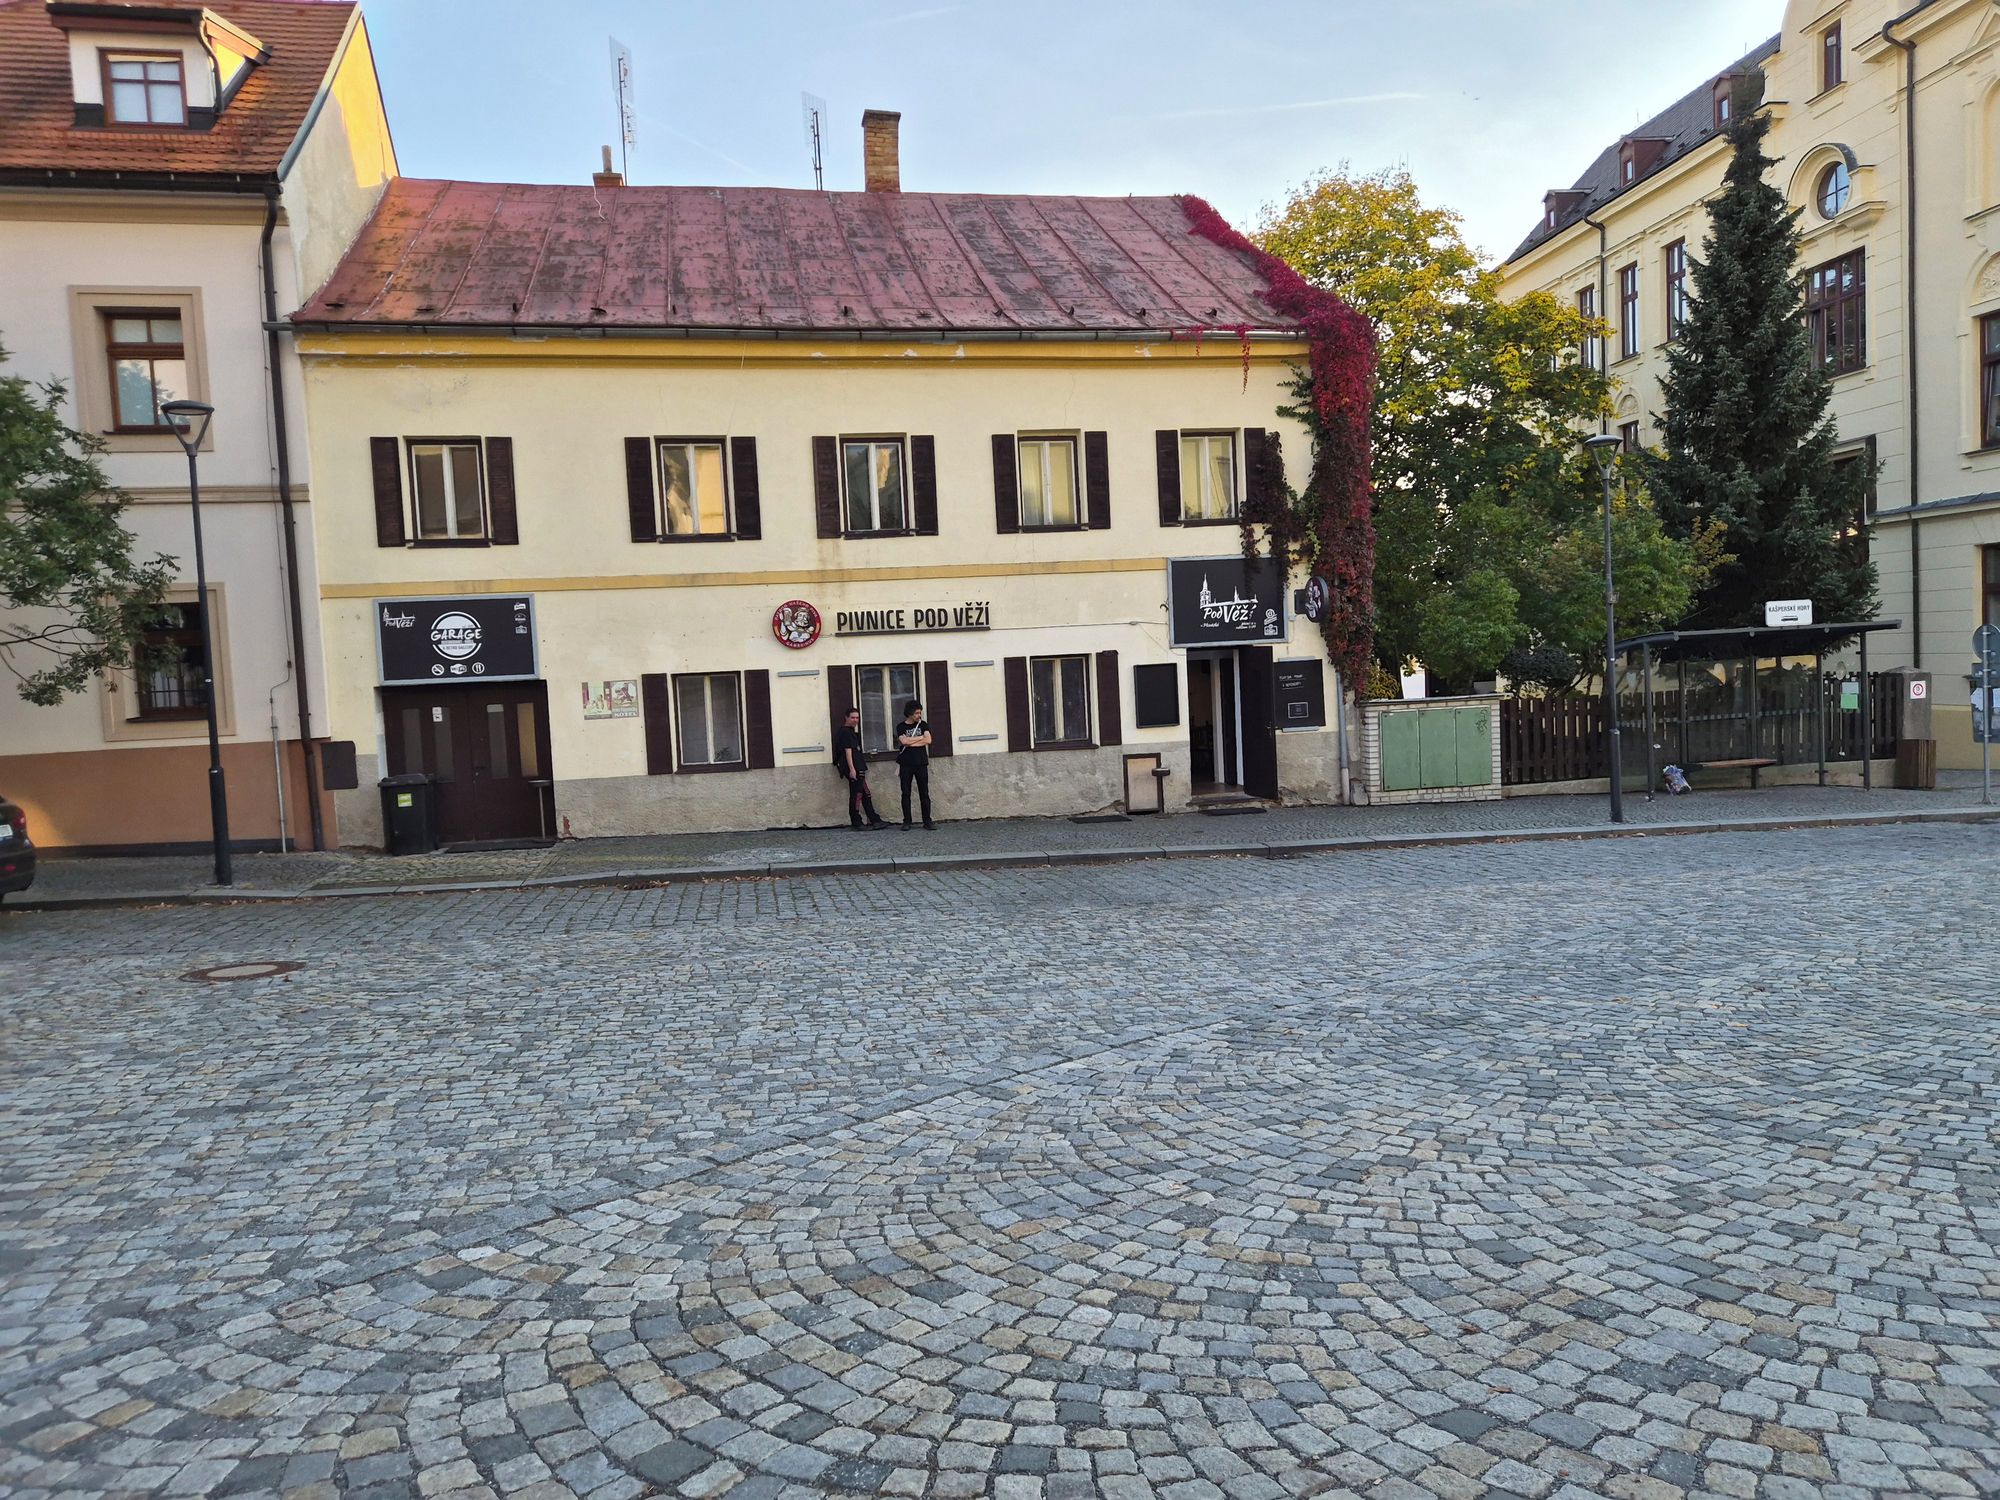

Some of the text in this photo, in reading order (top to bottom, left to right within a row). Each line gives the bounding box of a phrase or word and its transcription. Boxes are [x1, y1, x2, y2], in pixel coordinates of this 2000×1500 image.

[837, 601, 990, 631] PIVNICE POD VĚŽÍ
[430, 628, 482, 641] GARAGE
